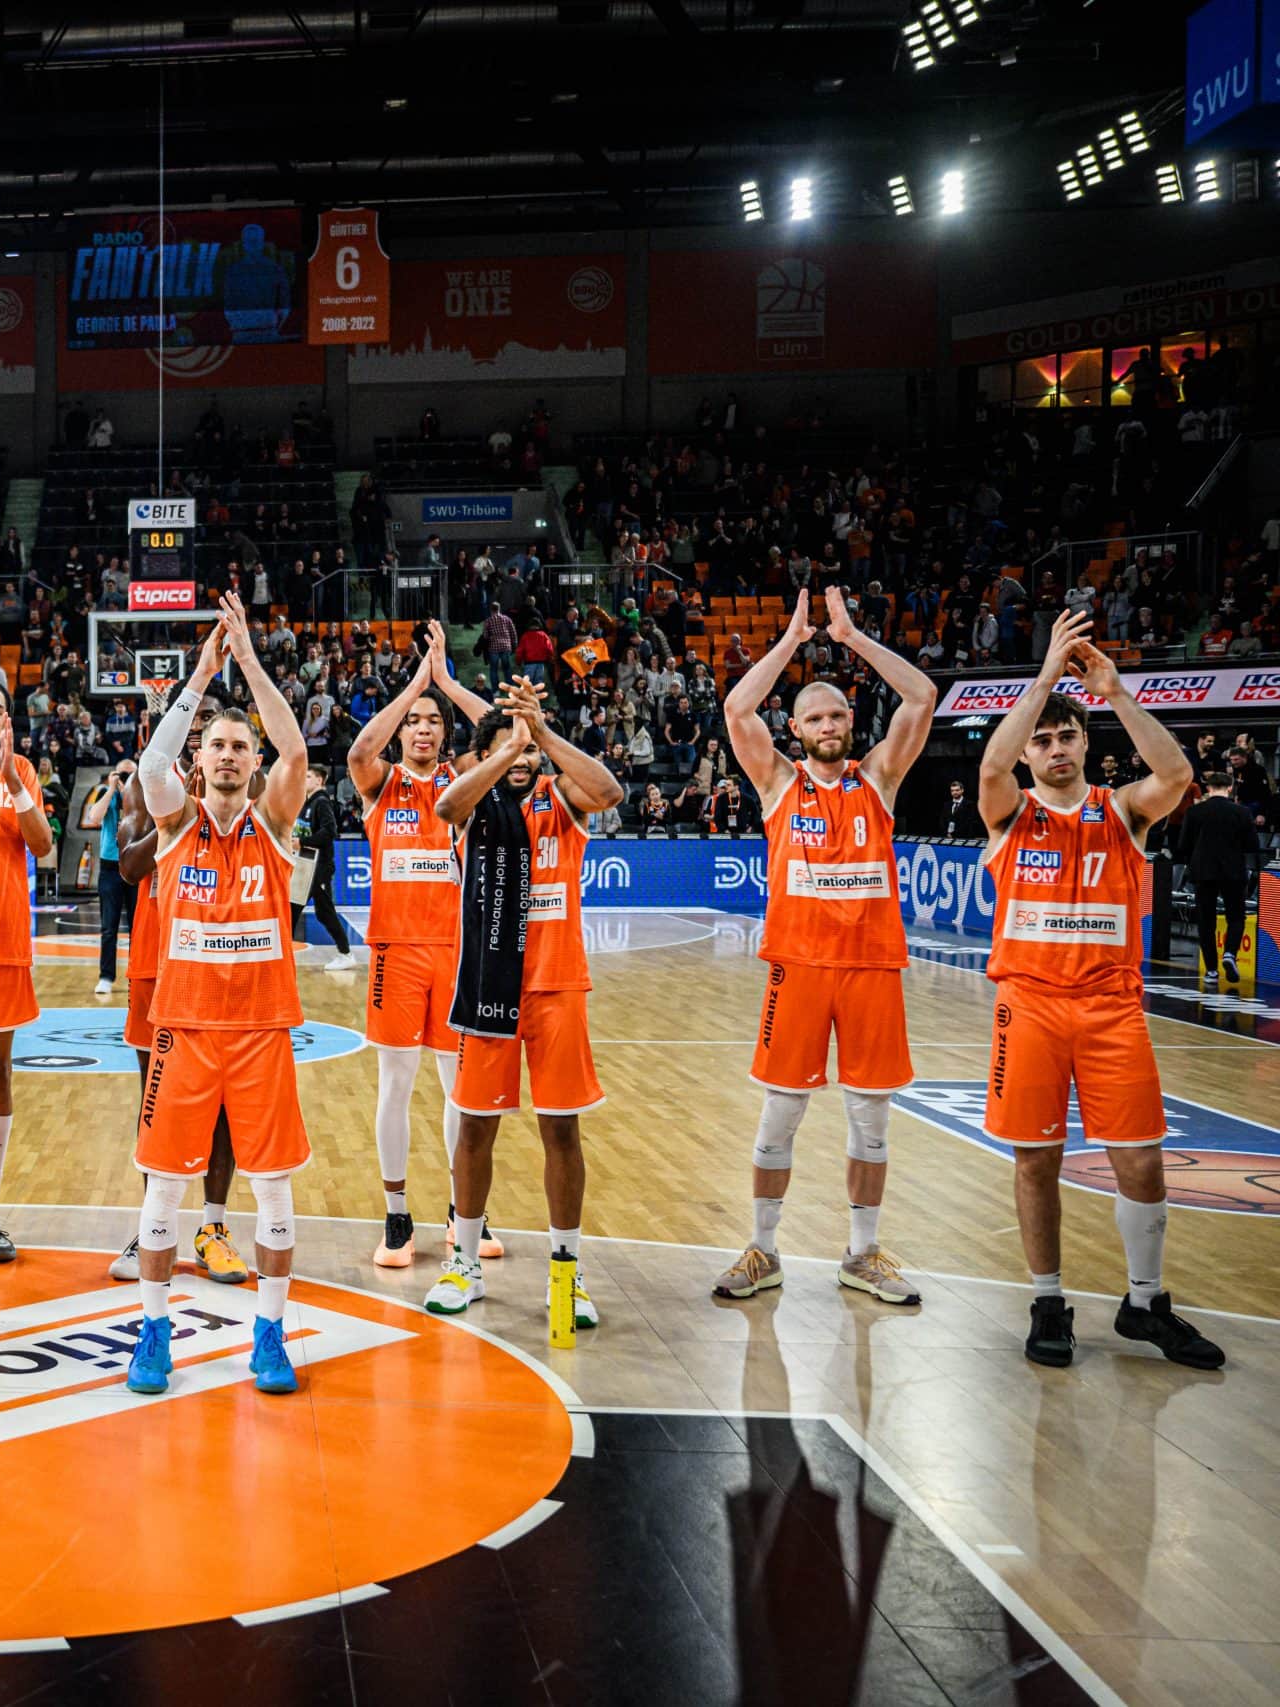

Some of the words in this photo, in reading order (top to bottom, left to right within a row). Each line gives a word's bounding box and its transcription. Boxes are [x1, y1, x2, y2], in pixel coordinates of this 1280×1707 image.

[1192, 57, 1249, 125] SWU
[93, 231, 144, 245] RADIO
[336, 245, 360, 290] 6
[445, 270, 474, 286] WE
[478, 269, 512, 285] ARE
[1123, 275, 1226, 305] ratiopharm
[444, 286, 513, 318] ONE
[76, 316, 121, 334] GEORGE
[123, 315, 138, 332] DE
[1006, 321, 1083, 353] GOLD
[1089, 298, 1217, 342] OCHSEN
[152, 505, 187, 519] BITE
[428, 503, 507, 517] SWU-Tribüne
[134, 584, 193, 606] tipico
[963, 685, 1022, 698] LIQUI
[1144, 676, 1215, 690] LIQUI
[955, 697, 1015, 710] MOLY
[1138, 690, 1207, 703] MOLY
[387, 810, 418, 823] LIQUI
[386, 822, 419, 835] MOLY
[853, 815, 867, 847] 8
[536, 836, 559, 870] 30
[1017, 849, 1058, 867] LIQUI
[1013, 867, 1059, 884] MOLY
[1082, 851, 1107, 888] 17
[240, 864, 266, 903] 22
[817, 874, 883, 889] ratiopharm
[178, 885, 215, 904] MOLY
[1044, 917, 1116, 932] ratiopharm
[203, 936, 271, 951] ratiopharm
[372, 952, 386, 1011] Allianz
[763, 988, 779, 1049] Allianz
[993, 1031, 1008, 1100] Allianz
[143, 1057, 165, 1129] Allianz
